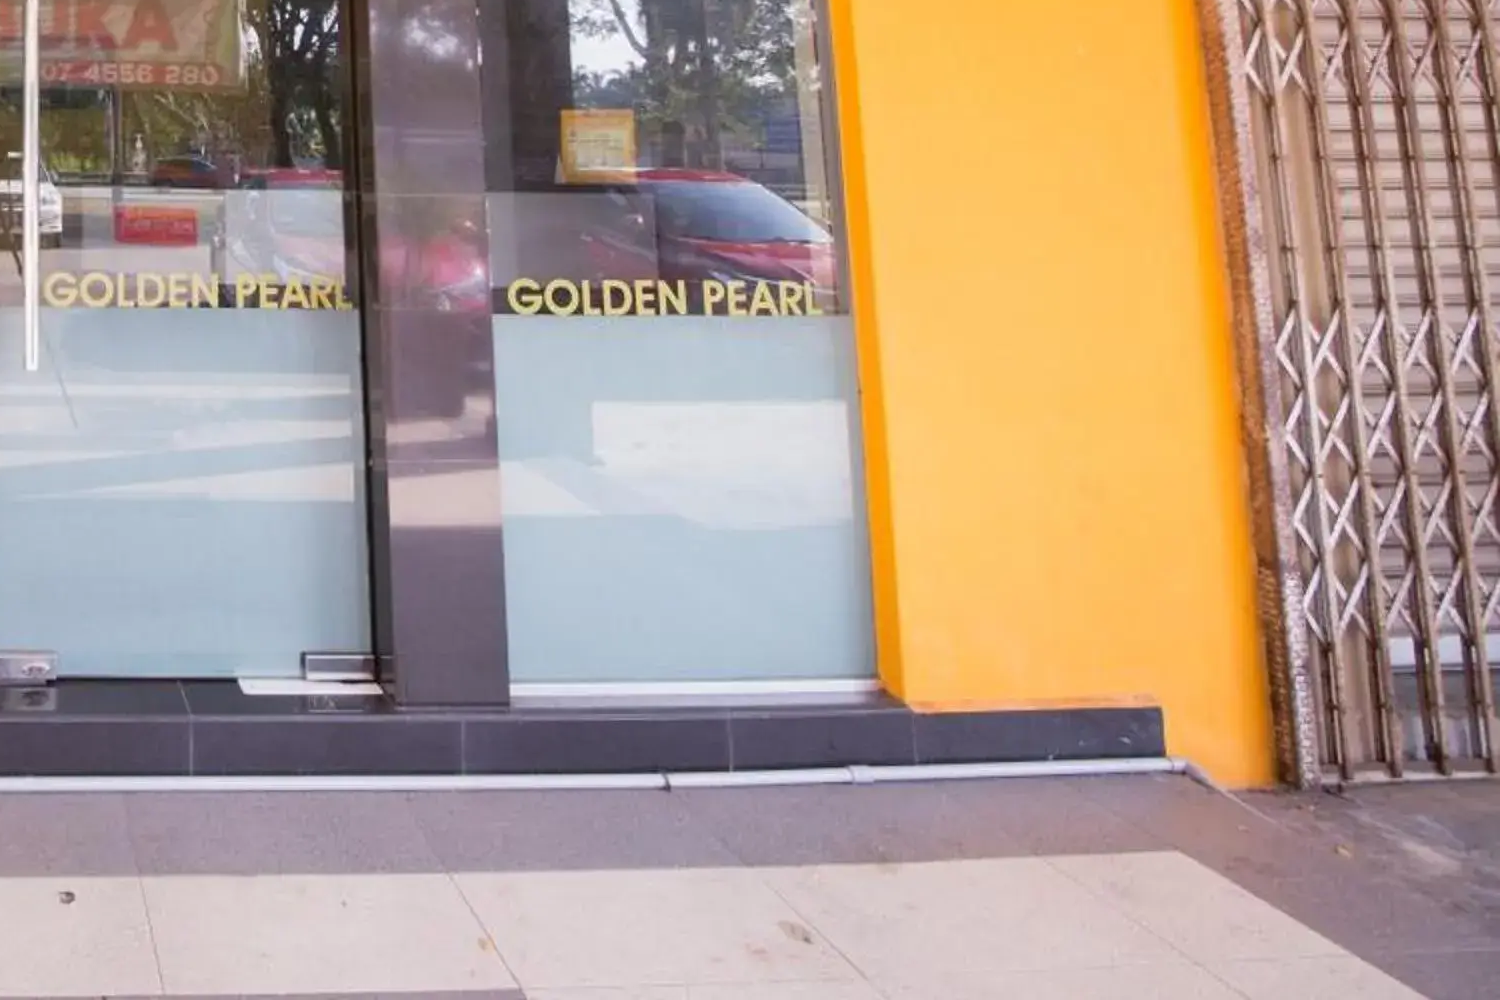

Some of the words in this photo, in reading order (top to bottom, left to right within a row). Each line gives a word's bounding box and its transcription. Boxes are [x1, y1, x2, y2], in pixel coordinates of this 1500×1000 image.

[166, 65, 220, 86] 280
[42, 271, 220, 309] GOLDEN
[232, 273, 354, 310] PEARL
[507, 277, 688, 317] GOLDEN
[702, 279, 824, 317] PEARL
